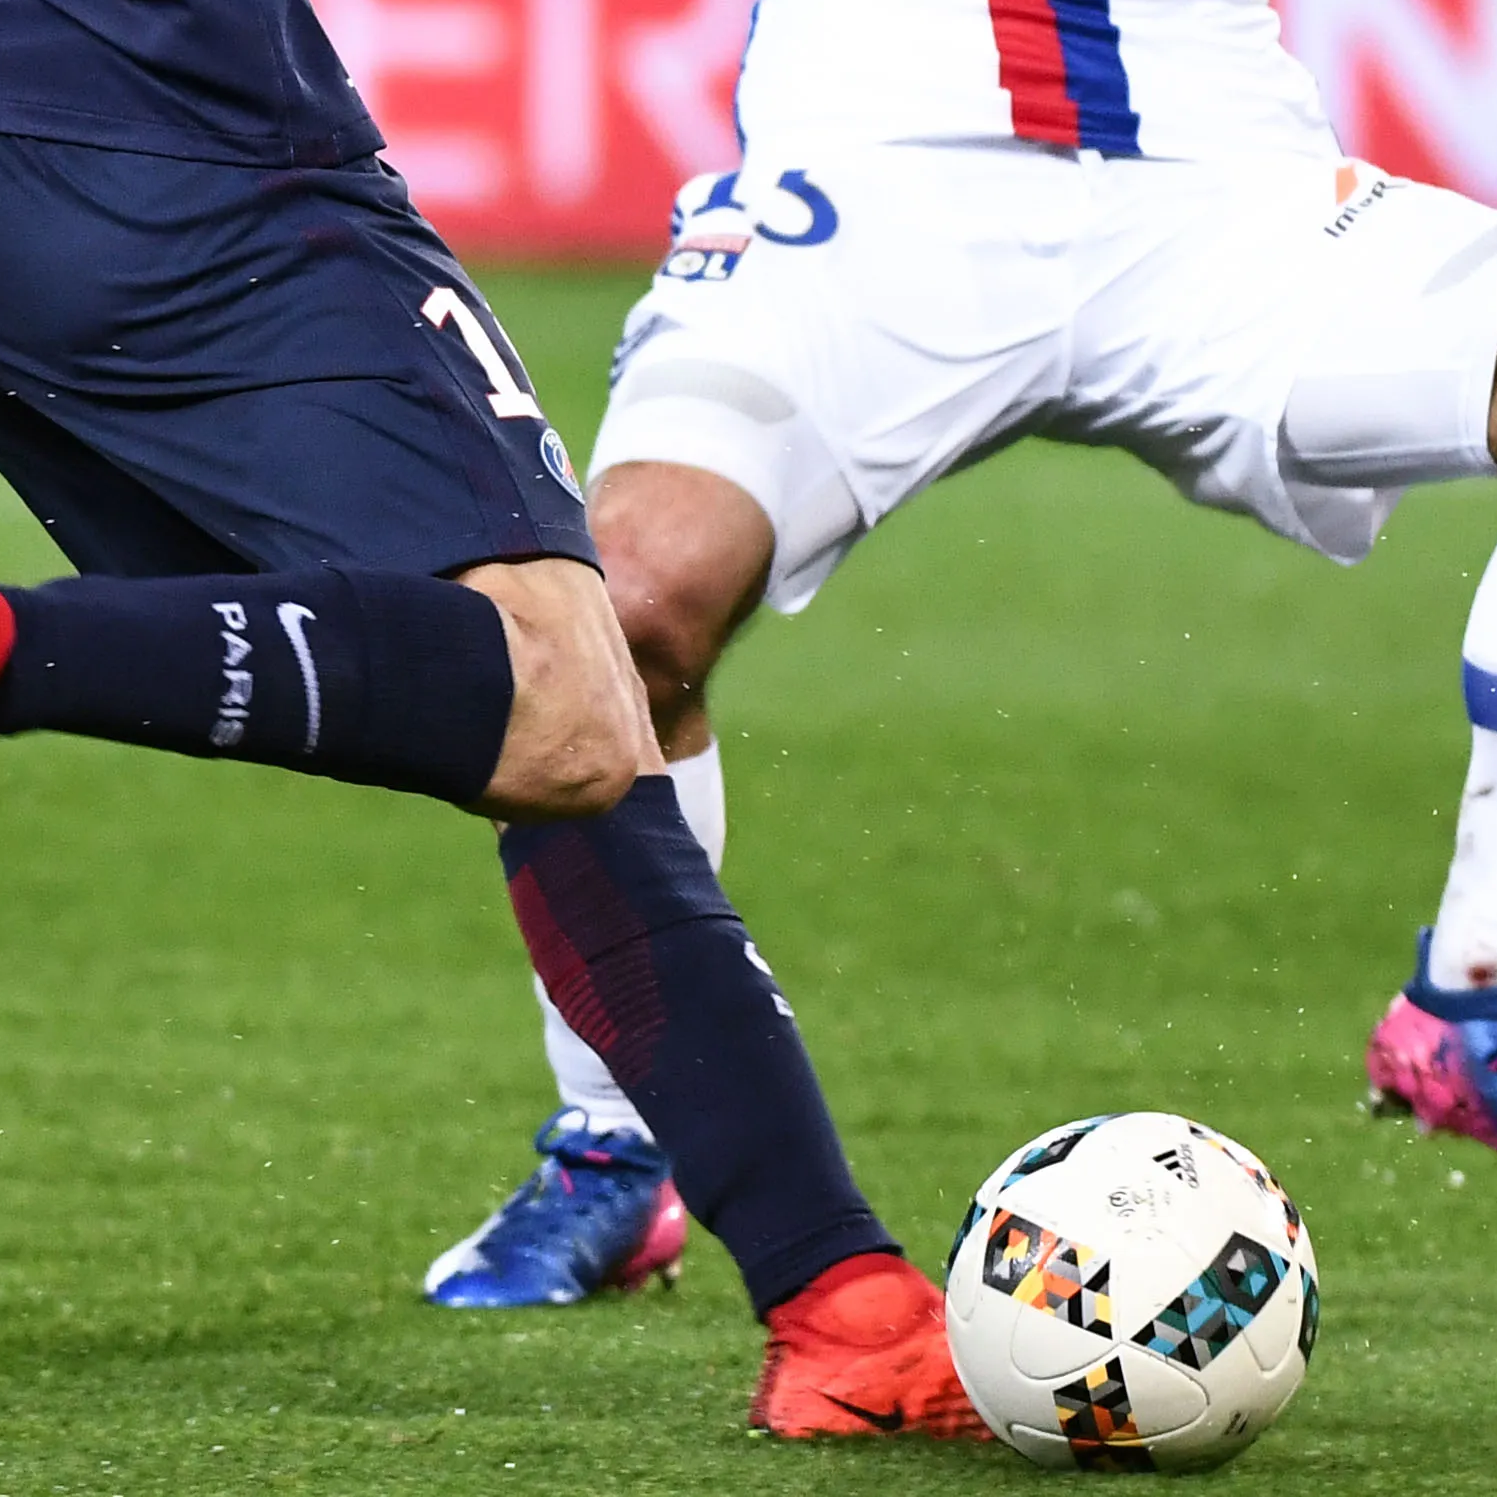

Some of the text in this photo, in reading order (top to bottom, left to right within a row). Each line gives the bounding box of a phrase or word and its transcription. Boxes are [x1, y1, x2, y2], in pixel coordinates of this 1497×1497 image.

[666, 250, 733, 281] OL
[419, 286, 544, 420] 1
[210, 602, 253, 747] PARIS
